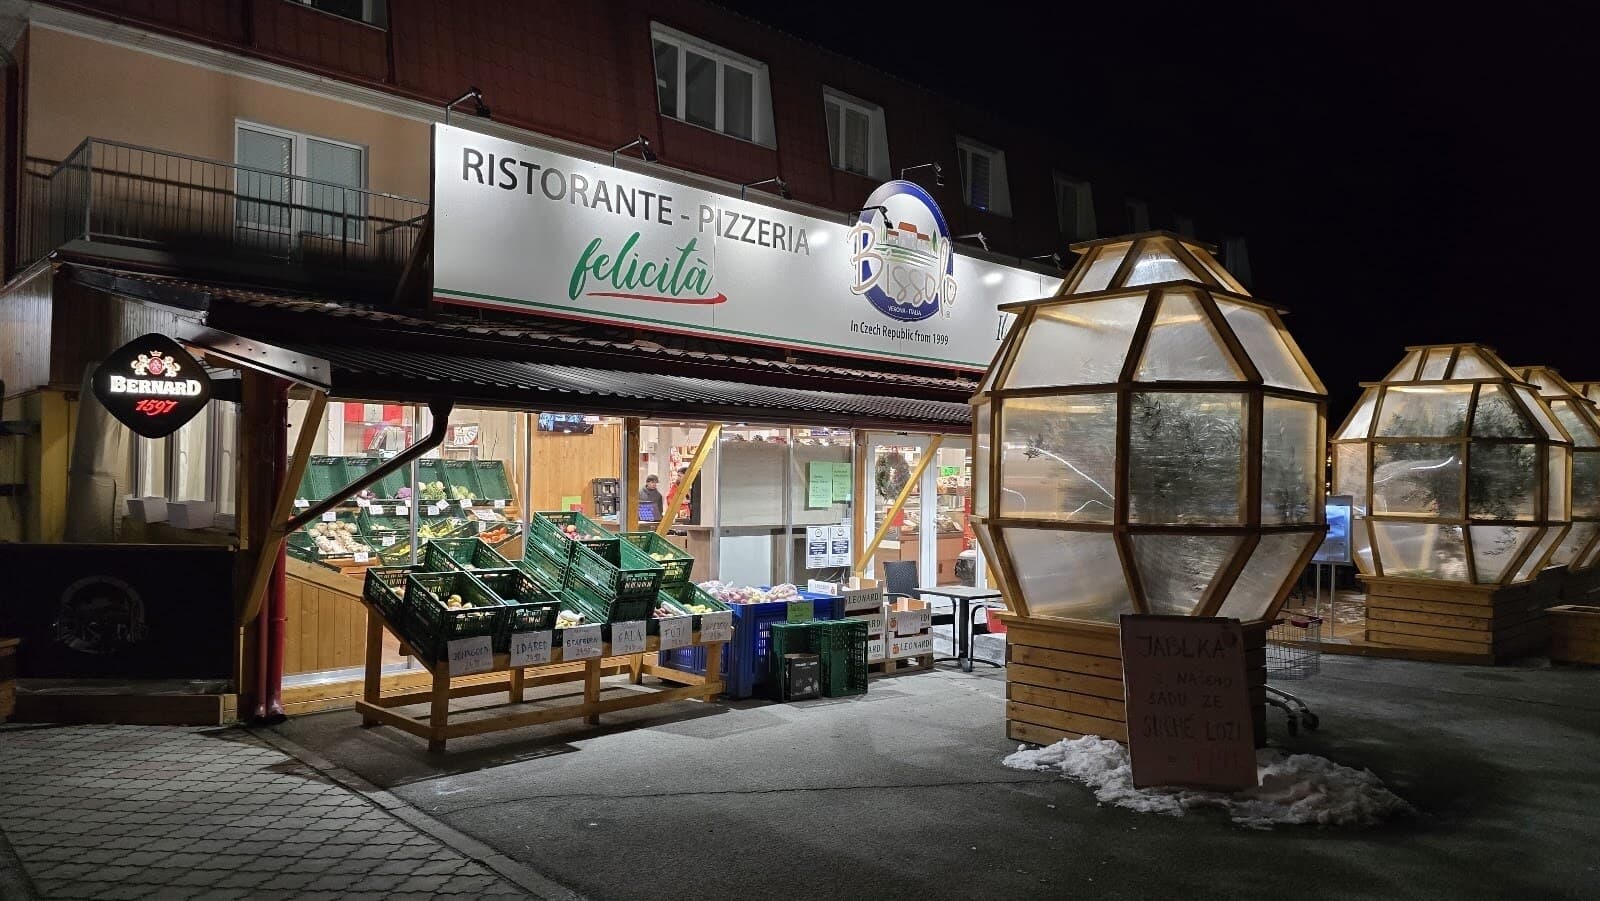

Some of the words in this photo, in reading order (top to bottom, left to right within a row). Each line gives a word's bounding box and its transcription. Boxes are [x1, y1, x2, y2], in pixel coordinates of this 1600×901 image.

[462, 147, 673, 226] RISTORANTE
[698, 204, 810, 256] PIZZERIA
[568, 231, 714, 300] felicità
[848, 223, 957, 317] Bissolo
[850, 320, 859, 332] In
[860, 321, 881, 336] Czech
[882, 325, 914, 340] Republic
[914, 330, 931, 344] from
[933, 333, 949, 345] 1999
[110, 375, 202, 396] BERNARD
[136, 399, 178, 416] 1597
[848, 592, 882, 604] LEONARDI
[515, 640, 549, 654] IDARED
[900, 639, 932, 650] LEONARDI
[1136, 635, 1225, 659] JABLKA
[1200, 694, 1225, 709] ZE
